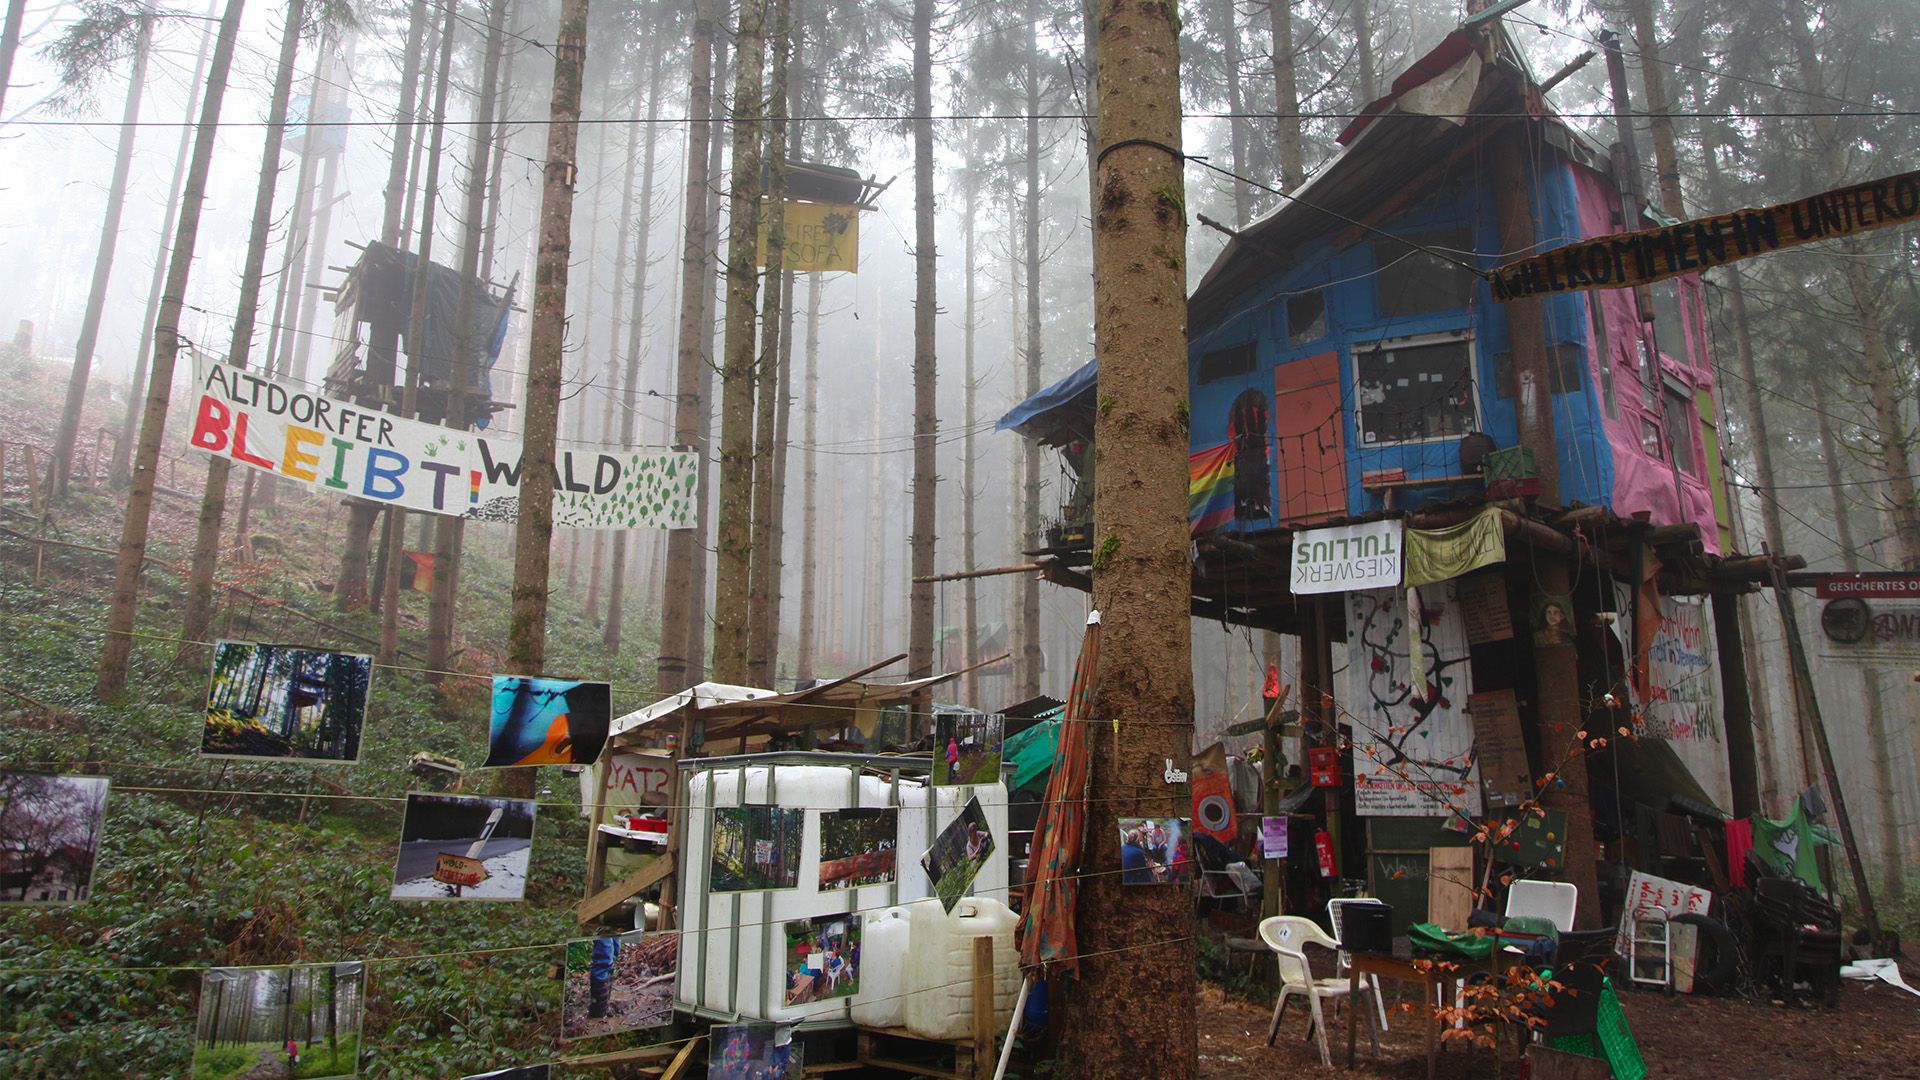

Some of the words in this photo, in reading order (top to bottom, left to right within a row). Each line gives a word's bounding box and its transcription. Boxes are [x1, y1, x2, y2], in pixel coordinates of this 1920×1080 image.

[1732, 208, 1779, 254] IN
[205, 364, 396, 448] ALTDORFER
[191, 394, 482, 511] BLEIBT!
[1297, 532, 1396, 564] TULLIUS
[1296, 555, 1396, 584] KIESWERK
[1829, 580, 1905, 592] GESICHERTES
